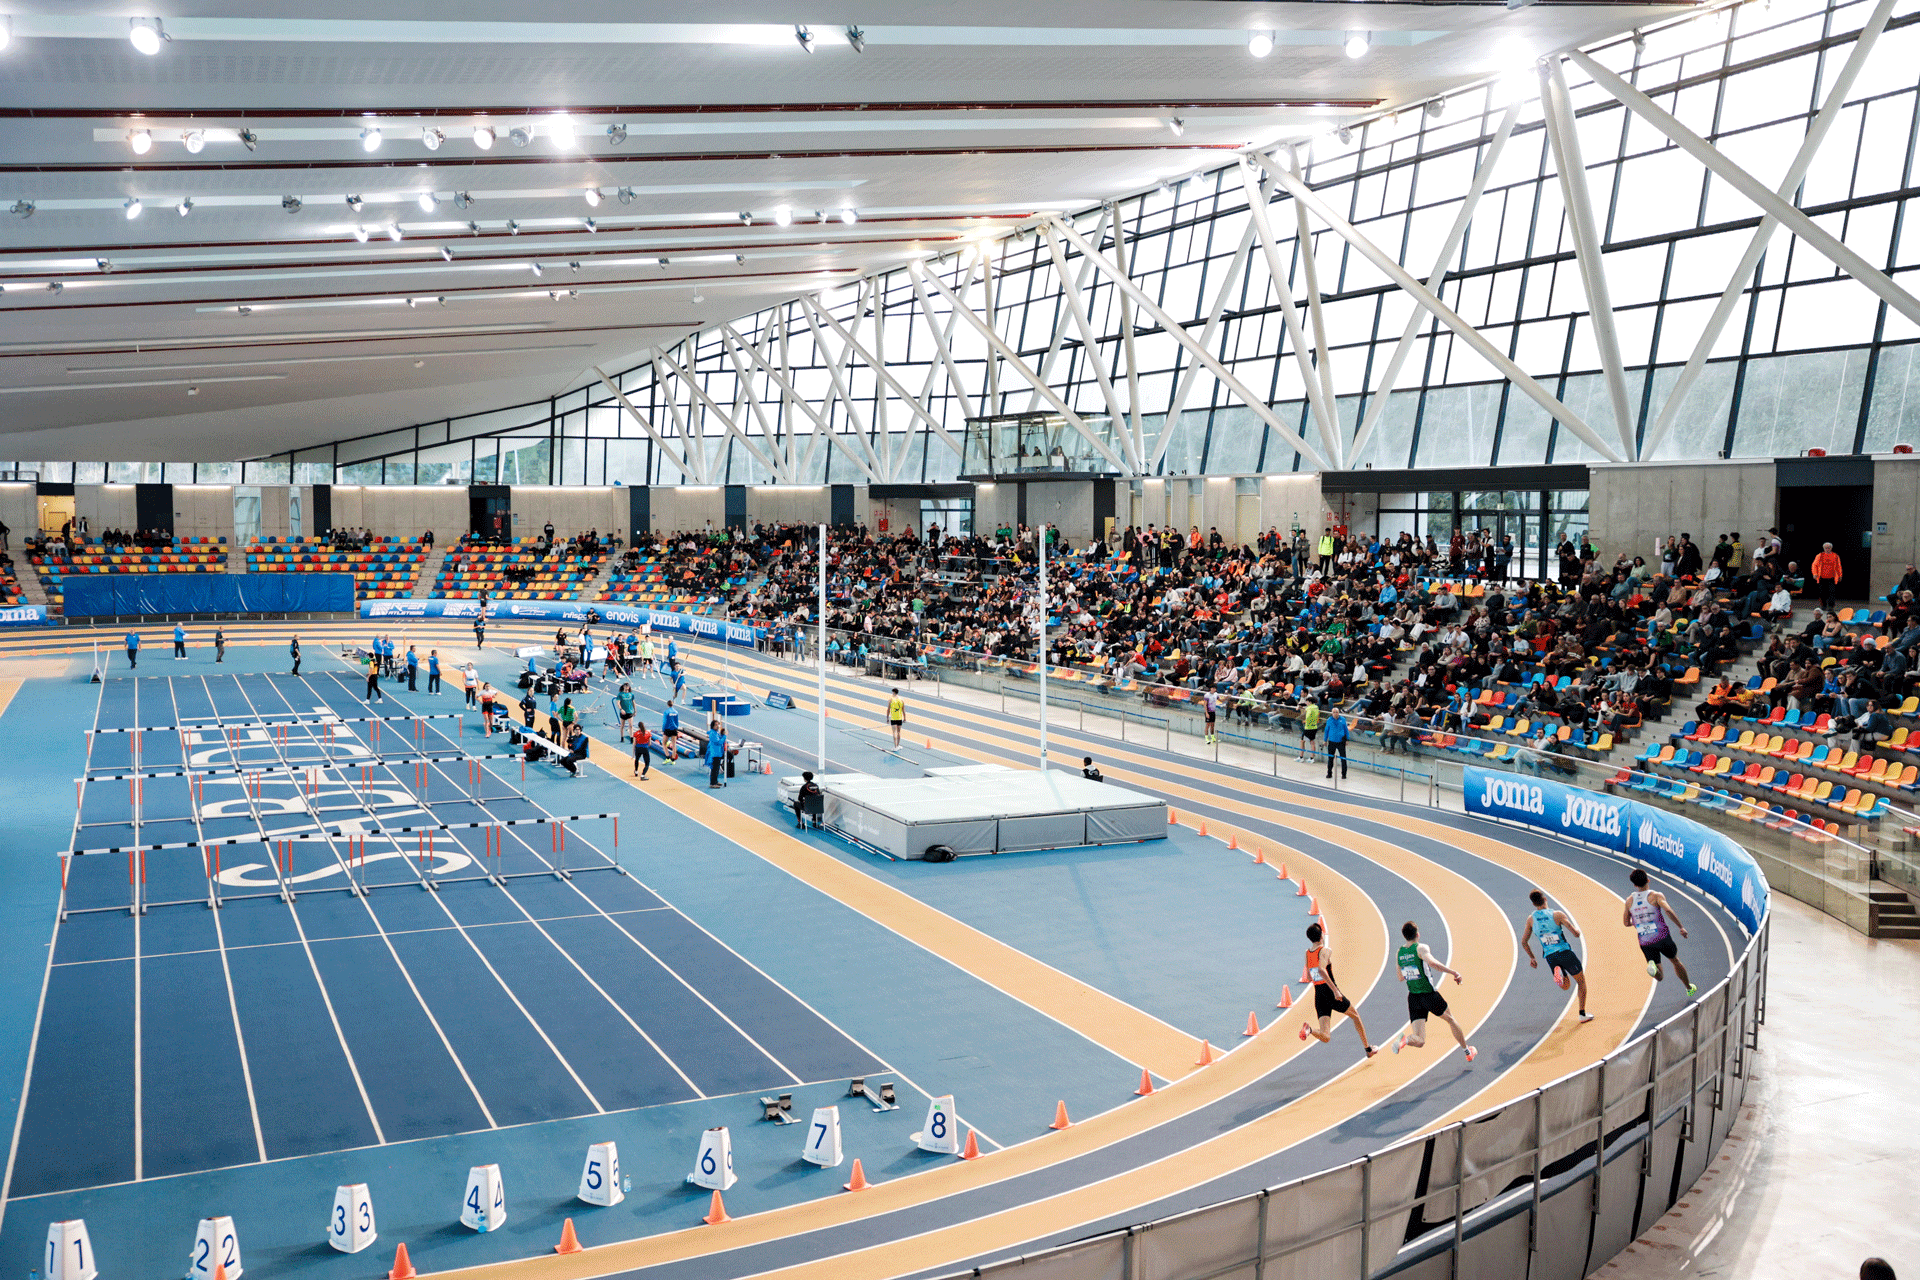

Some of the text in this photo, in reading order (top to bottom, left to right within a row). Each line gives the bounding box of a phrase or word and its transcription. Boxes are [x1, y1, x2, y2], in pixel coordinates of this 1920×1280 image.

[0, 608, 39, 622] oma
[606, 610, 639, 623] enovis
[1481, 776, 1544, 815] Joma
[1561, 793, 1621, 837] Joma
[1652, 827, 1684, 859] Iberdrola
[1709, 851, 1733, 888] Iberdrola
[814, 1122, 827, 1150] 7
[931, 1111, 947, 1139] 8
[587, 1160, 602, 1190] 5
[701, 1147, 716, 1175] 6
[467, 1185, 480, 1214] 4
[494, 1180, 503, 1208] 4
[334, 1204, 346, 1236] 3
[359, 1201, 371, 1233] 3
[49, 1240, 56, 1274] 1
[73, 1238, 84, 1270] 1
[196, 1237, 210, 1272] 2
[222, 1233, 235, 1268] 2
